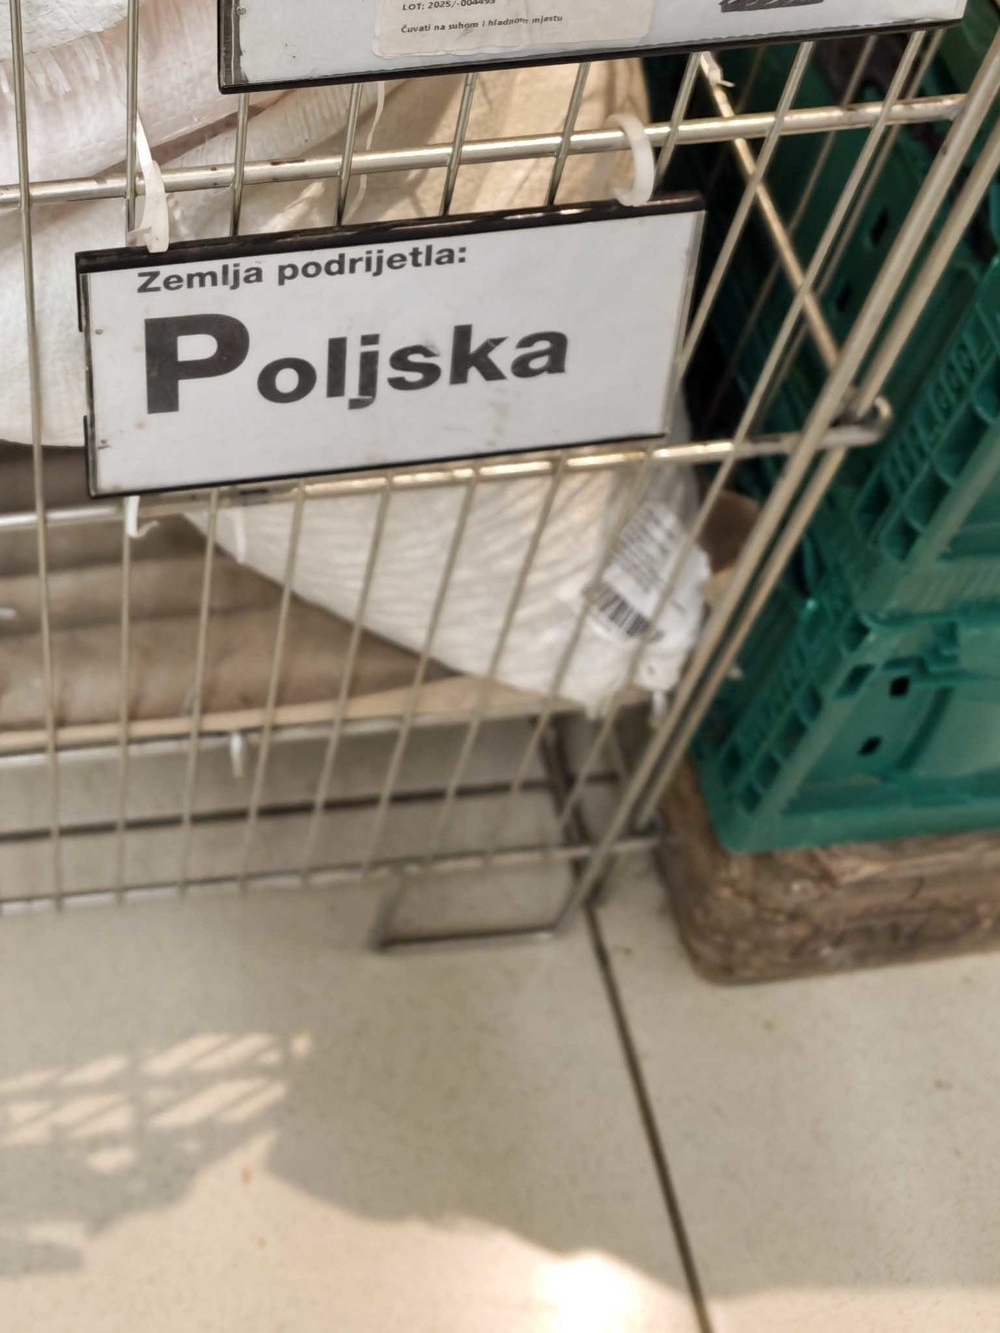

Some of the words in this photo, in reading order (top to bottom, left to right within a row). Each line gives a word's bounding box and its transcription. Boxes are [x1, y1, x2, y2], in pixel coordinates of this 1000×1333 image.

[402, 3, 424, 11] LOT:
[400, 23, 431, 33] Čuvati
[448, 21, 478, 30] suhom
[488, 17, 528, 27] hladnom
[532, 15, 563, 24] mjestu
[137, 263, 264, 293] Zemlja
[277, 244, 467, 286] podrijetla:
[144, 312, 570, 415] Poljska
